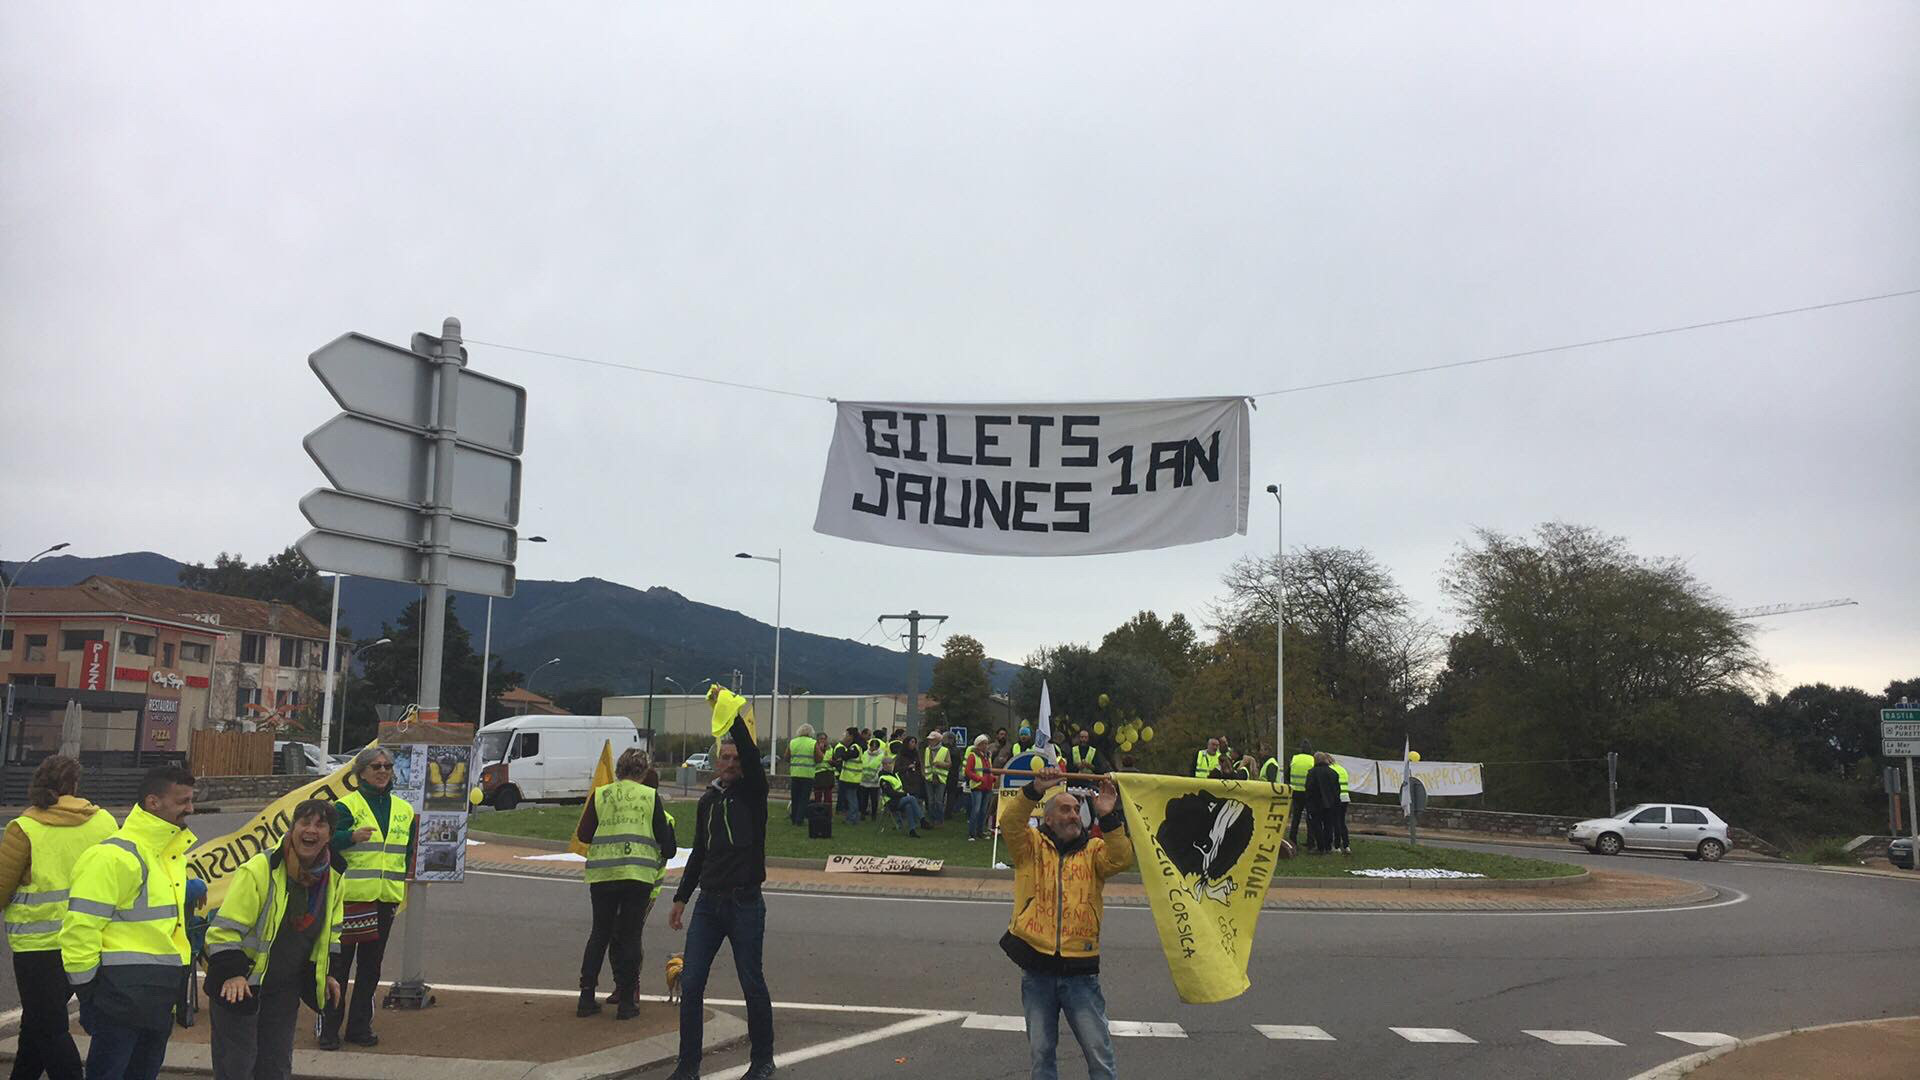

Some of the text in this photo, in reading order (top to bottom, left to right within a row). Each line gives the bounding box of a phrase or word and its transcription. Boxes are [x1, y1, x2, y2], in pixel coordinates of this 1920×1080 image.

[862, 410, 1100, 468] GILETS
[1107, 430, 1221, 495] 1 AN
[852, 466, 1092, 533] JAUNES
[833, 855, 853, 865] ON
[856, 857, 877, 865] NE
[1169, 889, 1197, 959] CORSICA
